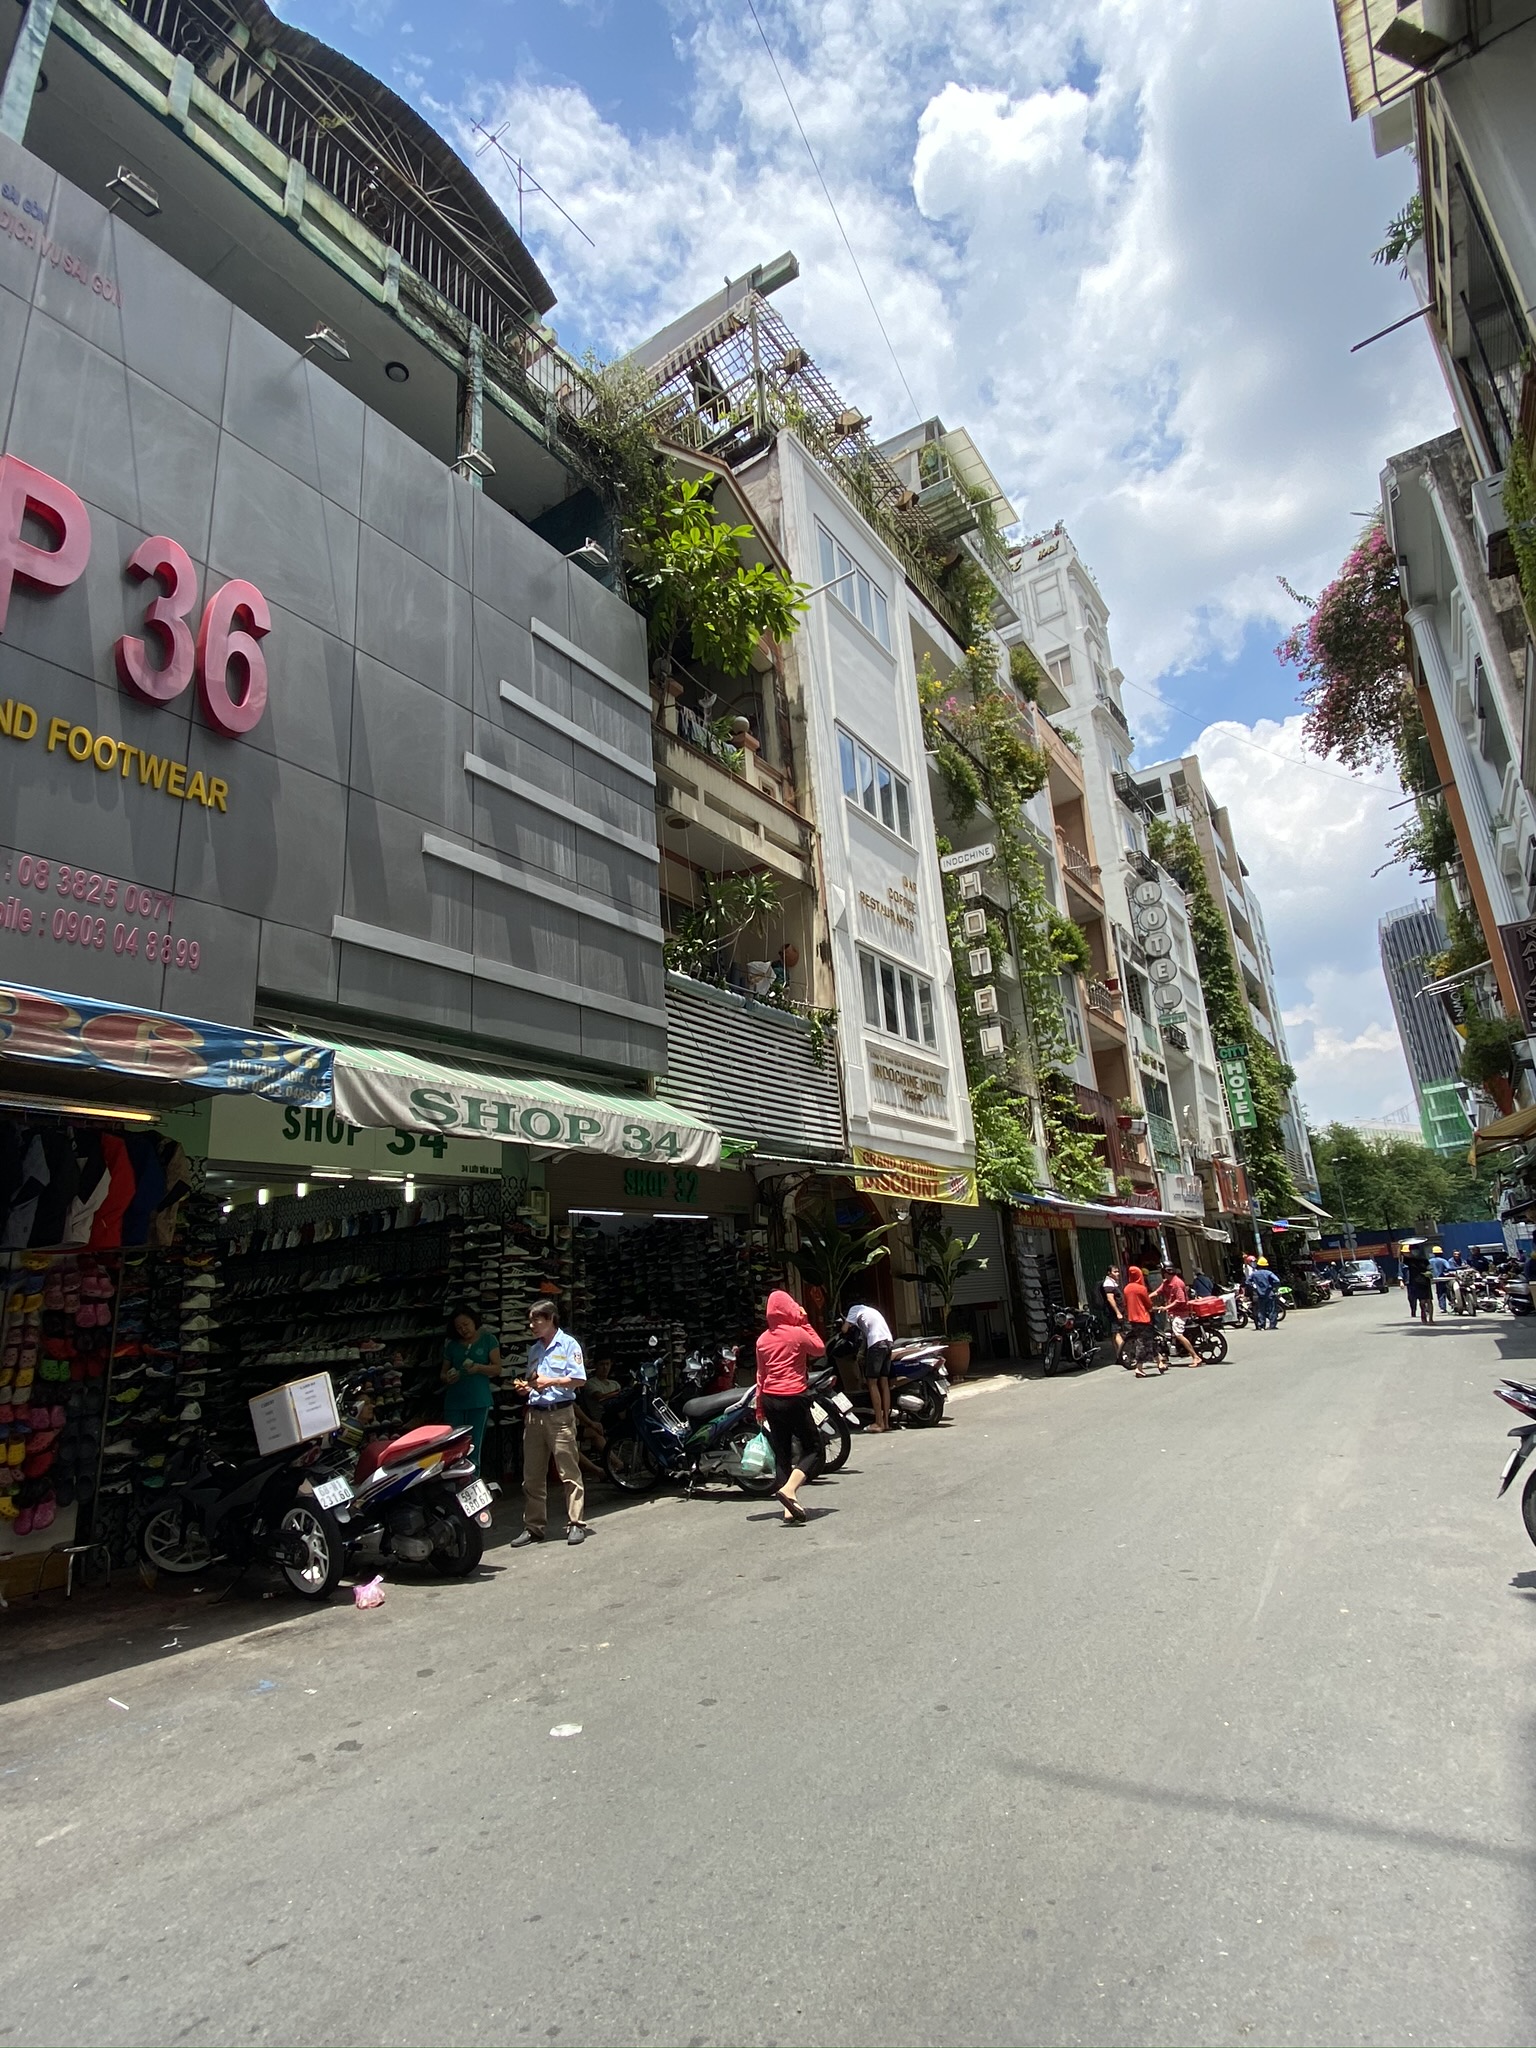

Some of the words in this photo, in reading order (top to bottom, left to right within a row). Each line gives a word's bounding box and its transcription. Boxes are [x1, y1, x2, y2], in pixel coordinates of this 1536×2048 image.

[114, 535, 272, 739] 36
[47, 716, 229, 813] FOOTWEAR
[18, 856, 50, 889] 08
[56, 866, 119, 908] 3825
[124, 885, 176, 922] 0671
[943, 847, 990, 868] INDOCHINE
[52, 908, 107, 948] 0903
[113, 923, 140, 956] 04
[961, 872, 1000, 1054] HOTEL
[1140, 884, 1177, 1008] HOTEL
[873, 1063, 920, 1090] INDOCHINE
[920, 1079, 946, 1098] HOTEL
[1219, 1045, 1246, 1059] CITY
[409, 1087, 604, 1148] SHOP
[621, 1123, 682, 1159] 34
[1227, 1062, 1252, 1128] HOTEL
[624, 1168, 668, 1197] SHOP
[674, 1167, 699, 1204] 32
[862, 1151, 897, 1169] GRAND
[900, 1160, 938, 1177] OPENING
